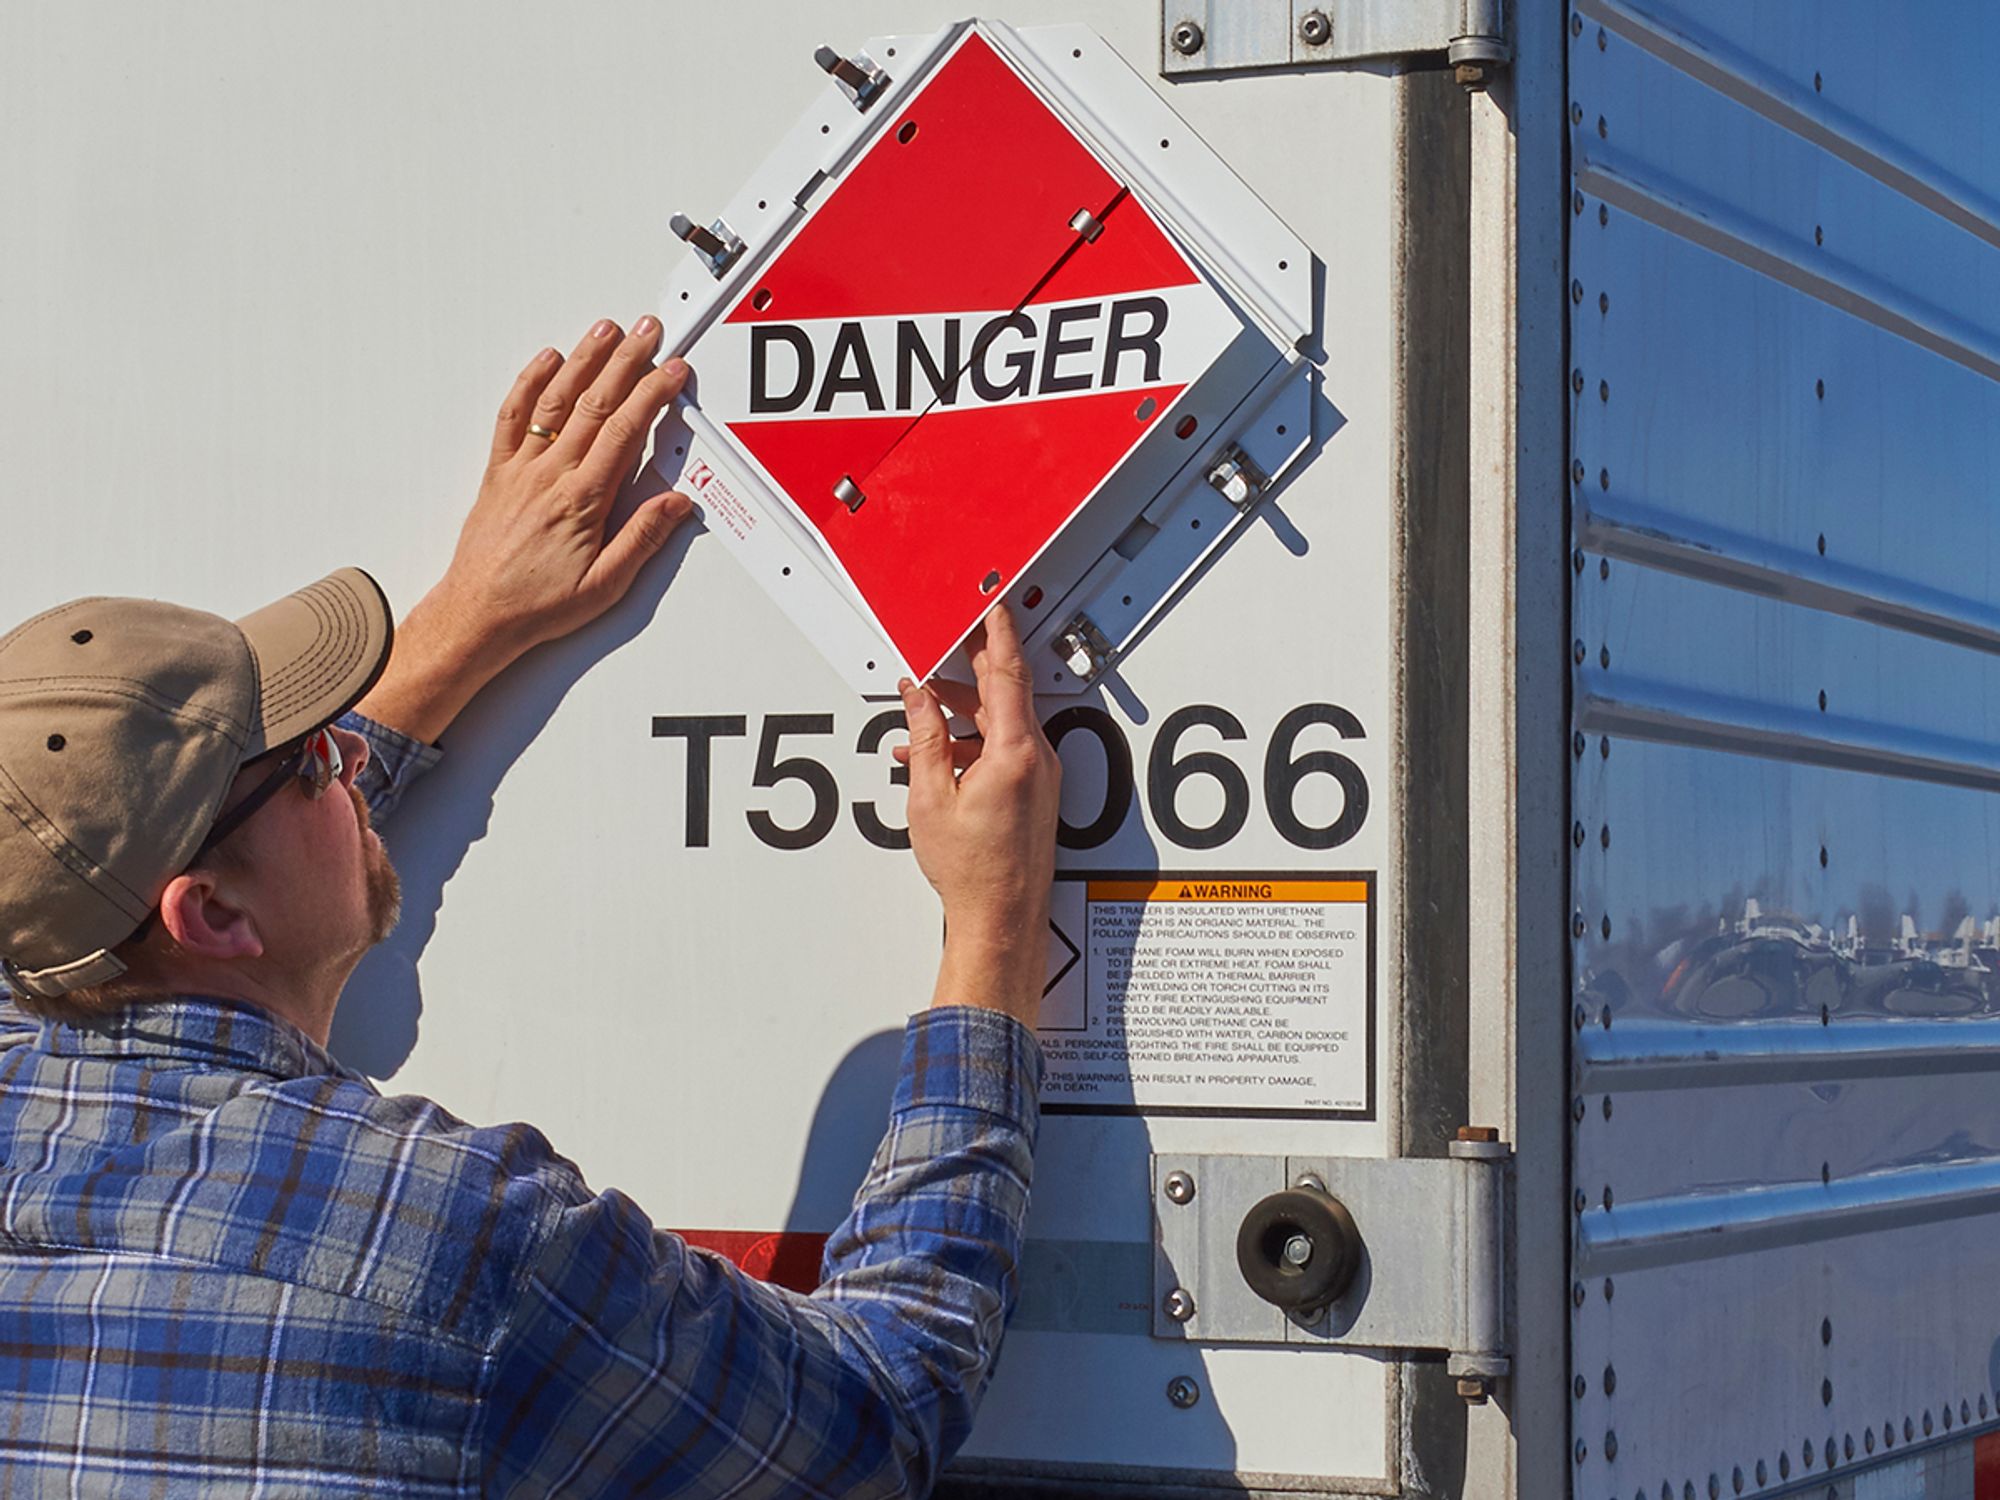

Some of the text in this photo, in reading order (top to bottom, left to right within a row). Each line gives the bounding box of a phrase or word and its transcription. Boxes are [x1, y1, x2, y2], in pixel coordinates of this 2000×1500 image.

[750, 296, 1169, 414] DANGER
[652, 703, 1369, 850] T53066
[1193, 885, 1272, 898] WARNING
[1094, 907, 1325, 917] THIS TRAILER IS INSULATED WITH URETHANE
[1126, 918, 1162, 927] WHICH
[1164, 918, 1175, 928] IS
[1177, 919, 1192, 928] AN
[1194, 919, 1244, 928] ORGANIC
[1304, 919, 1324, 928] THE
[1092, 930, 1153, 939] FOLLOWING
[1155, 930, 1229, 939] PRECAUTIONS
[1232, 930, 1278, 940] SHOULD
[1278, 931, 1292, 940] BE
[1106, 948, 1160, 957] URETHANE
[1164, 948, 1195, 957] FOAM
[1197, 948, 1222, 958] WILL
[1224, 949, 1254, 958] BURN
[1256, 949, 1290, 958] WHEN
[1291, 949, 1345, 959] EXPOSED
[1108, 960, 1122, 969] TO
[1123, 960, 1156, 969] FLAME
[1160, 960, 1177, 969] OR
[1179, 960, 1228, 969] EXTREME
[1264, 960, 1295, 969] FOAM
[1298, 960, 1332, 970] SHALL
[1106, 971, 1316, 982] BE SHIELDED WITH A THERMAL BARRIER
[1106, 983, 1329, 994] WHEN WELDING OR TORCH CUTTING IN ITS
[1153, 994, 1178, 1003] FIRE
[1180, 994, 1262, 1004] EXTINGUISHING
[1265, 996, 1326, 1005] EQUIPMENT
[1107, 1006, 1150, 1015] SHOULD
[1151, 1006, 1166, 1015] BE
[1168, 1006, 1211, 1016] READILY
[1092, 1017, 1288, 1028] 2. FIRE INVOLVING URETHANE CAN BE
[1106, 1029, 1185, 1039] EXTINGUISHED
[1185, 1030, 1213, 1039] WITH
[1256, 1030, 1302, 1040] CARBON
[1304, 1031, 1348, 1041] DIOXIDE
[1040, 1040, 1340, 1053] ALS. PERSONNEL FIGHTING THE FIRE SHALL BE EQUIPPED
[1082, 1052, 1172, 1062] SELF-CONTAINED
[1173, 1053, 1234, 1063] BREATHING
[1051, 1073, 1074, 1082] THIS
[1076, 1073, 1125, 1083] WARNING
[1126, 1074, 1150, 1083] CAN
[1151, 1074, 1191, 1084] RESULT
[1195, 1074, 1206, 1084] IN
[1207, 1075, 1265, 1084] PROPERTY
[1044, 1083, 1061, 1092] OR
